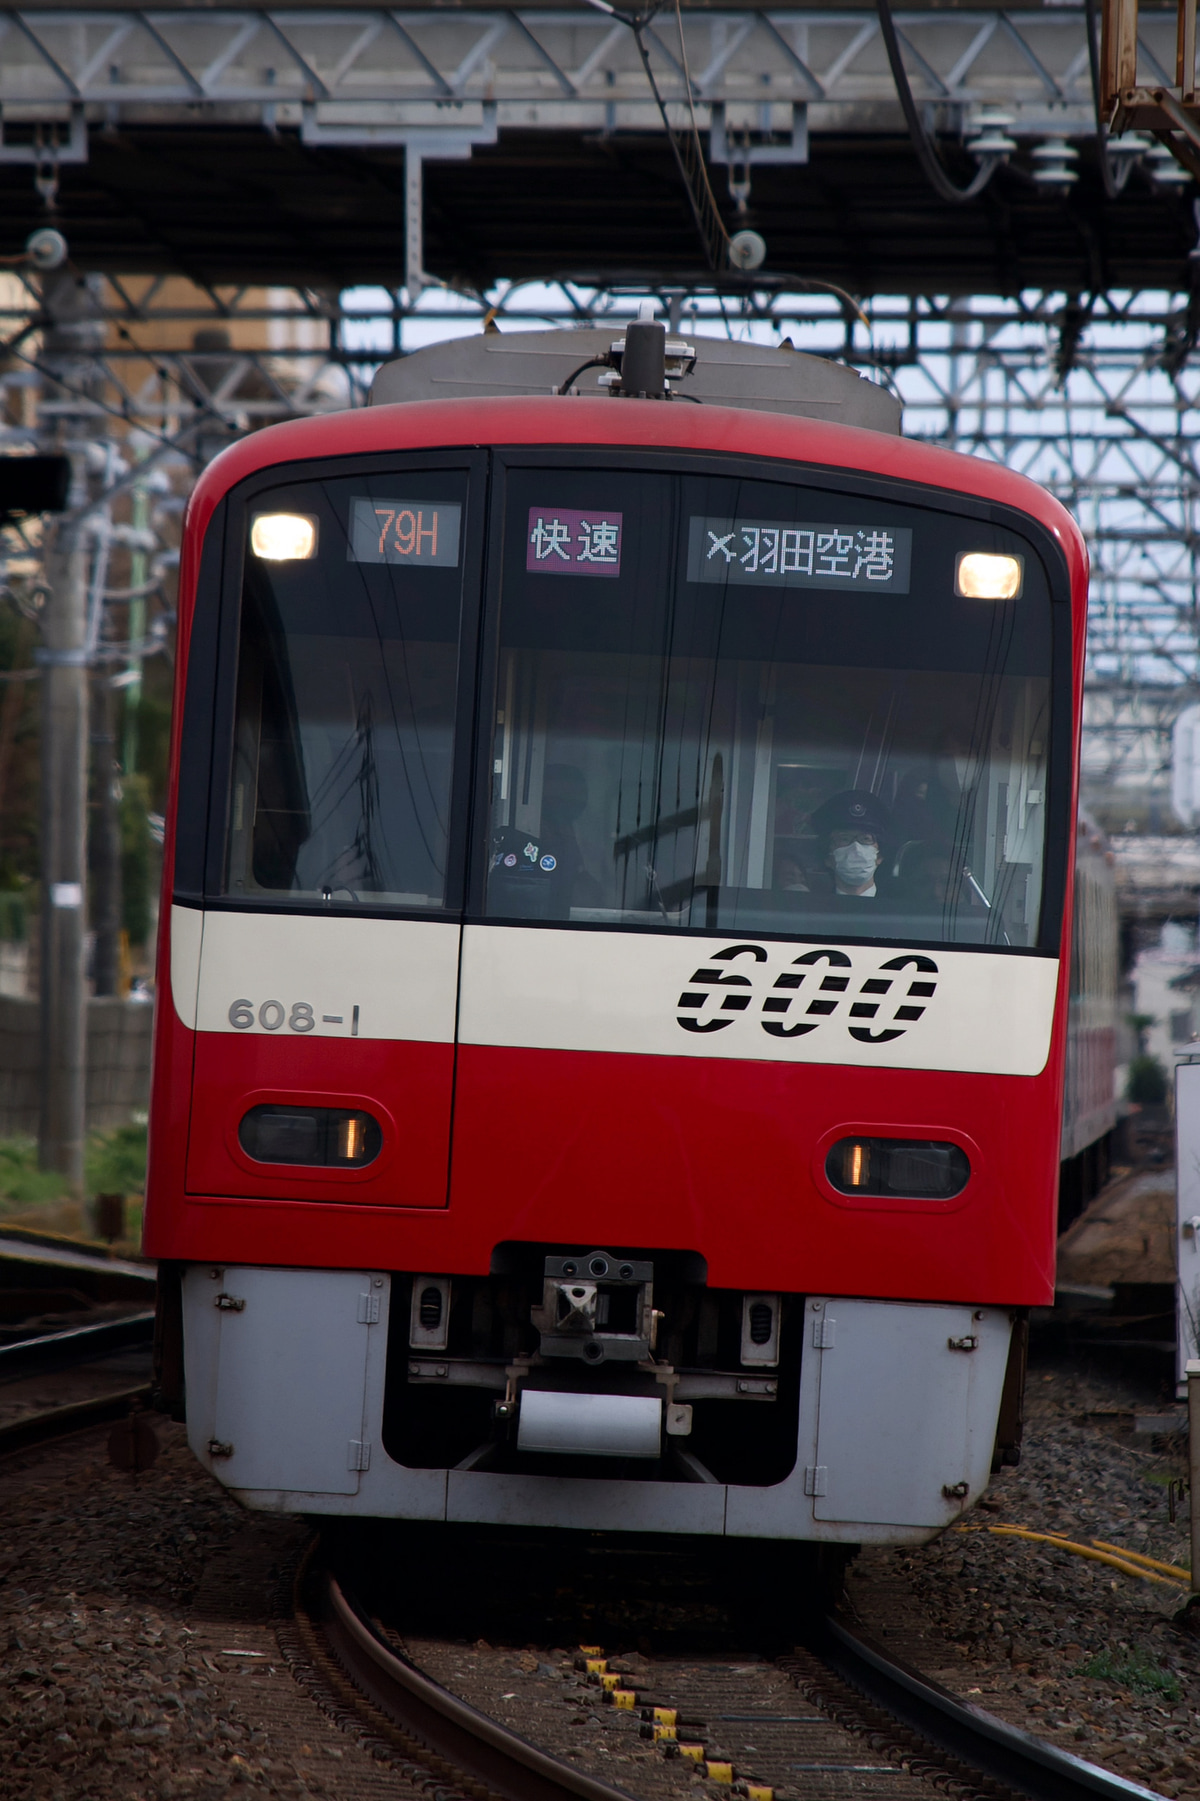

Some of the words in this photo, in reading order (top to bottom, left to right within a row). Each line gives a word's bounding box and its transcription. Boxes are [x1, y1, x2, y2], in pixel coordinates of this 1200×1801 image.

[374, 509, 438, 556] 79H
[530, 517, 619, 563] 快速
[740, 526, 895, 581] 羽田空港
[676, 944, 939, 1043] 600
[228, 998, 360, 1037] 608-1
